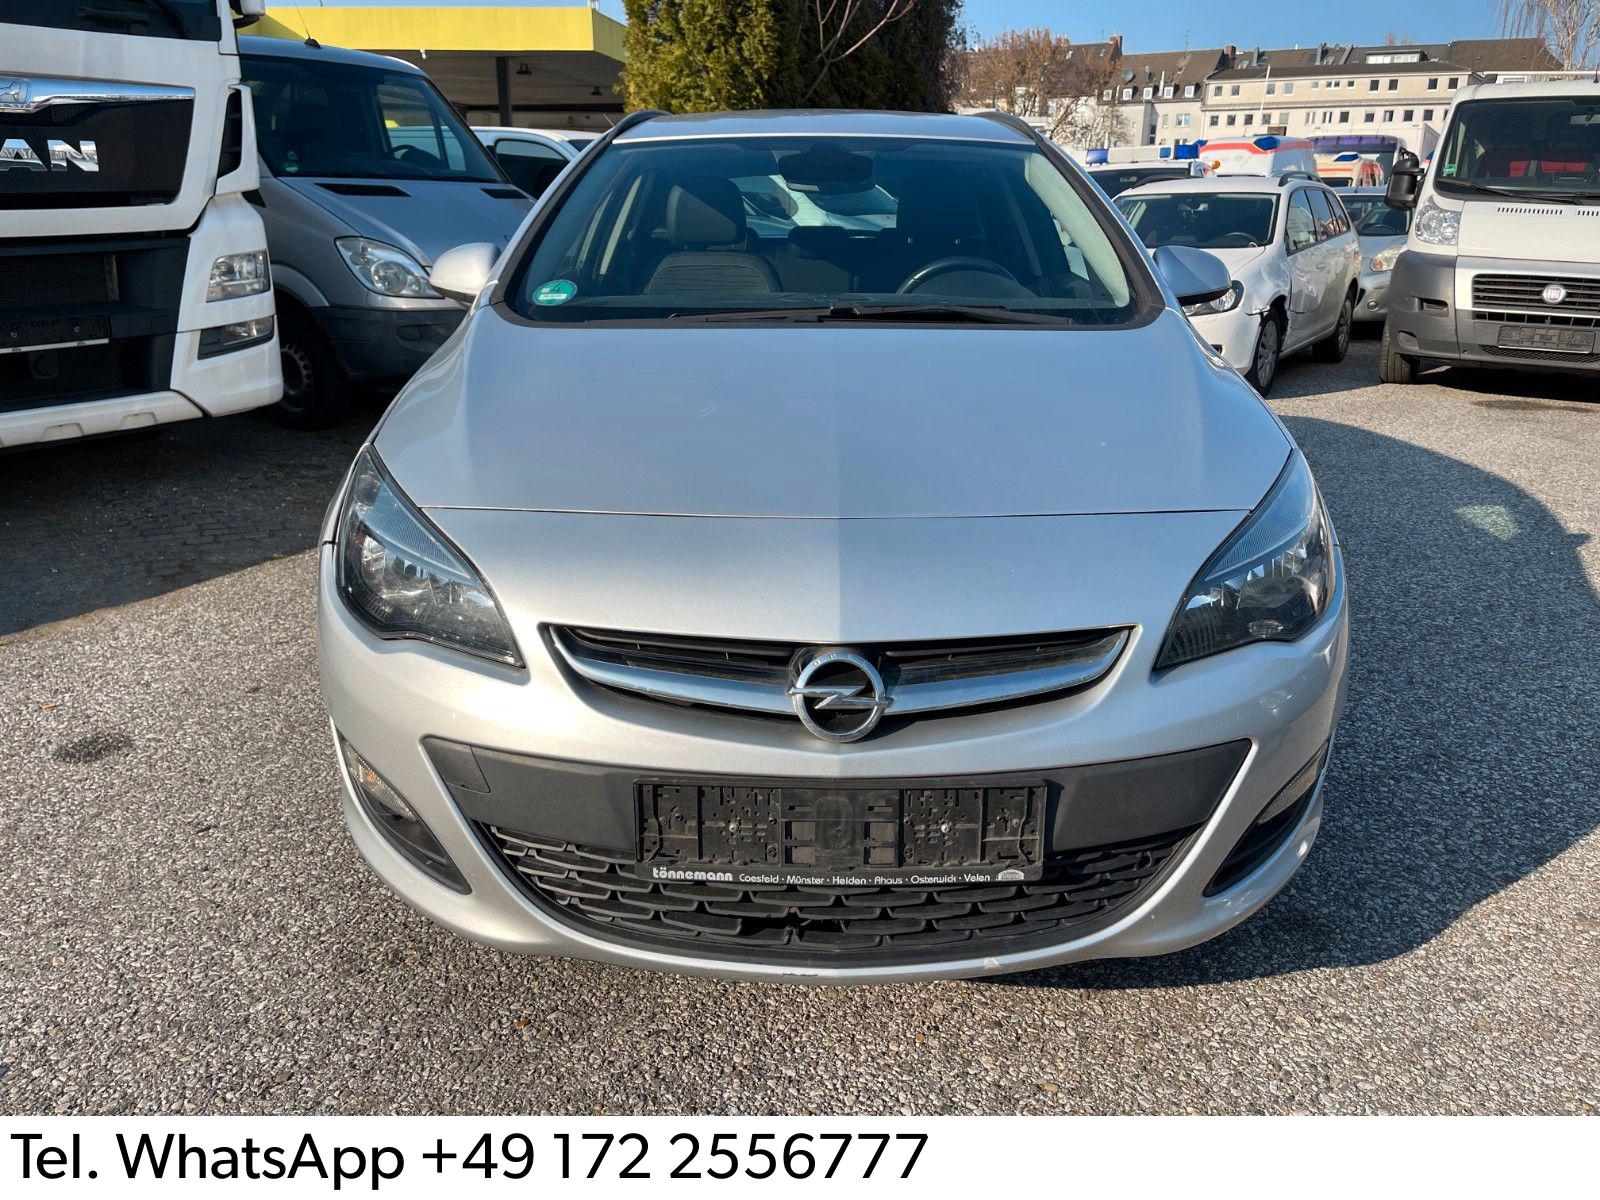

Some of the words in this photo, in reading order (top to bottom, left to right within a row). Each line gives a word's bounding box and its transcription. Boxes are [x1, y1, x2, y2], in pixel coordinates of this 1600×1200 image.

[652, 866, 733, 881] tönnemann
[739, 873, 779, 883] Coesfeld
[786, 874, 825, 884] Münster
[832, 875, 867, 885] Heiden
[874, 876, 903, 884] Ahaus
[910, 875, 957, 884] Osterwick
[963, 873, 991, 882] Velen
